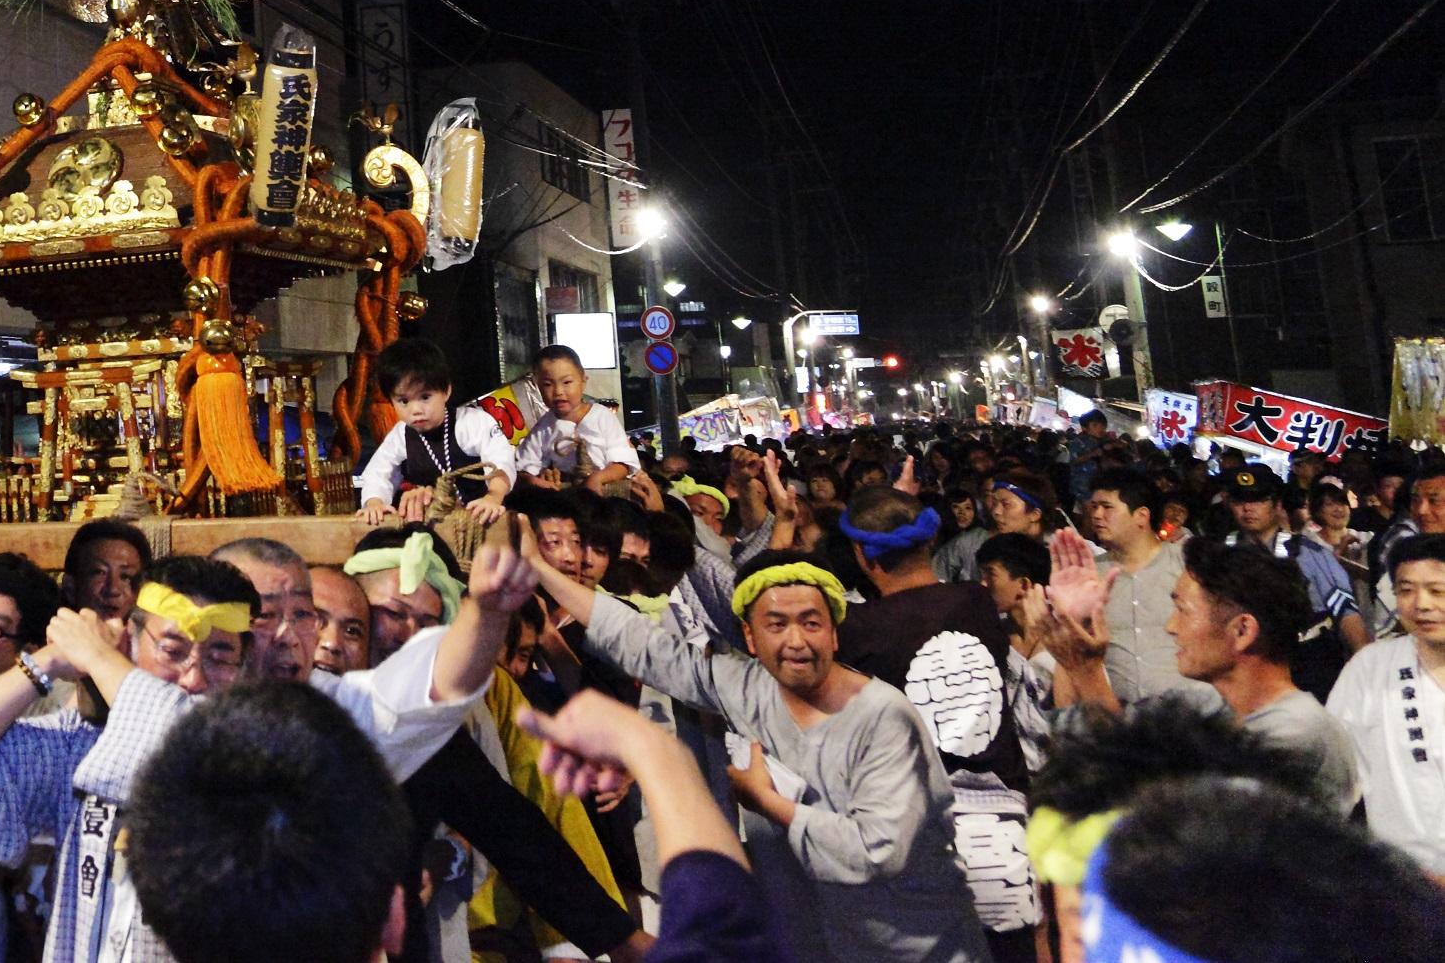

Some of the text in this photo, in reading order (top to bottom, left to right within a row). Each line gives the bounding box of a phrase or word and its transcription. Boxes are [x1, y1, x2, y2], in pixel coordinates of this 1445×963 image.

[649, 315, 667, 331] 40
[1056, 333, 1102, 368] 氷
[1160, 409, 1188, 440] 氷
